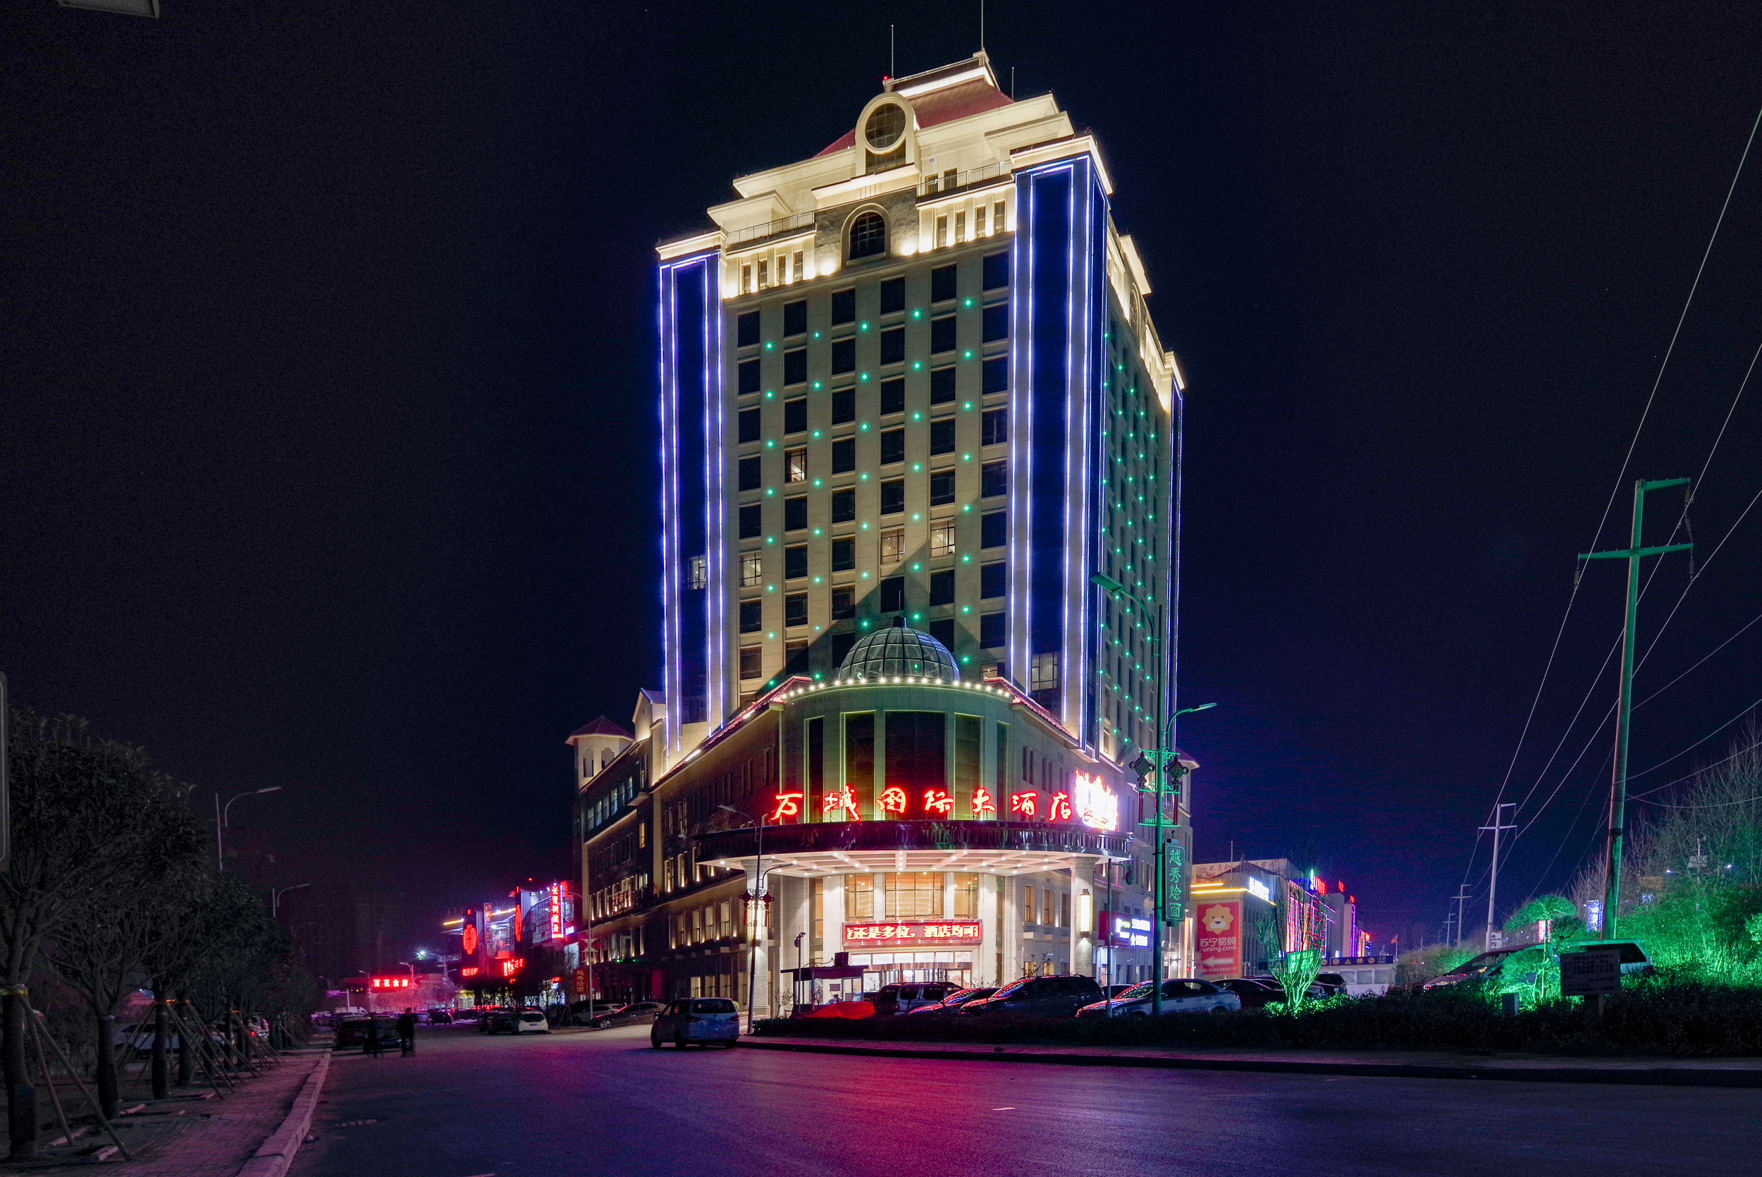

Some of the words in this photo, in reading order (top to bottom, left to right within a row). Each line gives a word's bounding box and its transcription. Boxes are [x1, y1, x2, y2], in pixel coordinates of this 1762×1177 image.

[771, 784, 1072, 821] 万城国际大酒店
[1168, 848, 1183, 918] 越秀烩面
[1199, 936, 1237, 947] 苏宁易购
